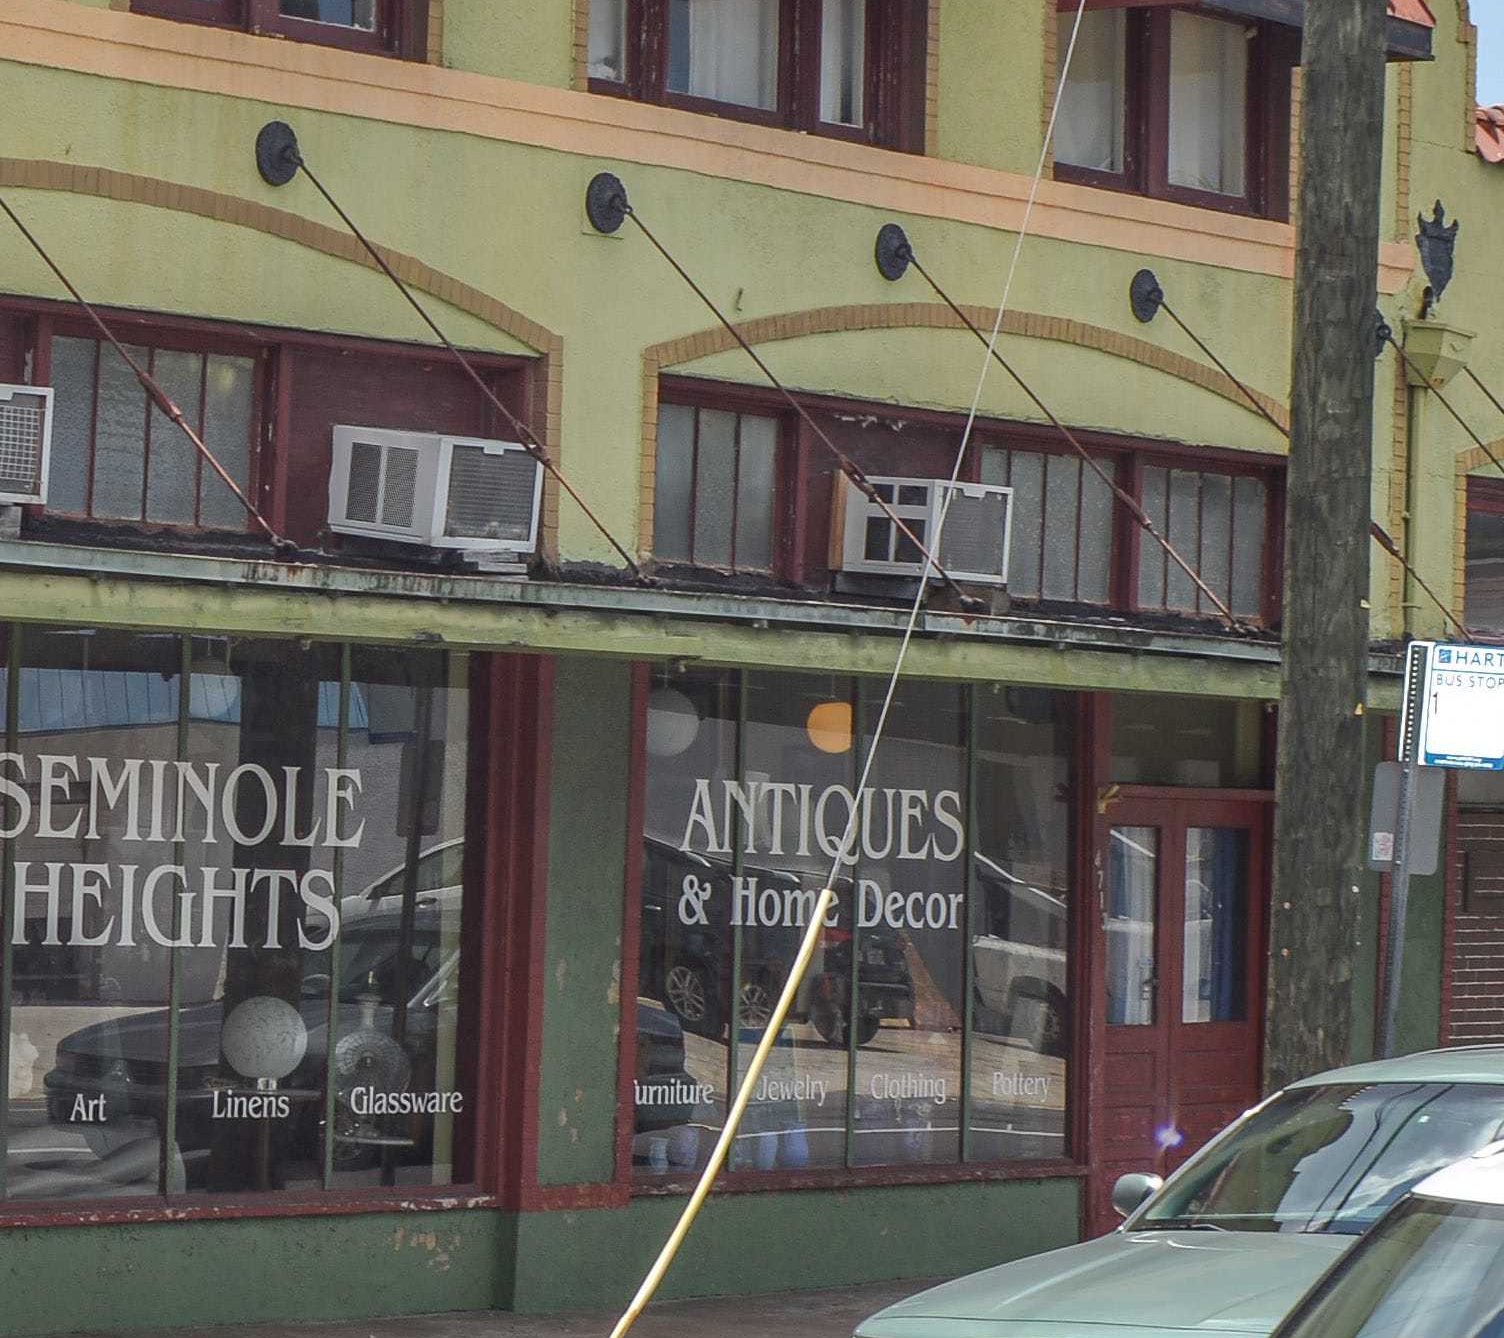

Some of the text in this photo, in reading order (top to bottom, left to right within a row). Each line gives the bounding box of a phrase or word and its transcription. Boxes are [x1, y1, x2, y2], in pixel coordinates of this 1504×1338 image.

[1436, 673, 1504, 690] BUS STOP
[678, 778, 966, 866] ANTIQUES
[10, 861, 341, 952] HEIGHTS
[678, 874, 712, 926] &
[856, 879, 965, 930] Decor
[70, 1085, 464, 1123] Art Linens Glassware
[634, 1070, 1051, 1107] urniture Jewelry Clothing Pottery
